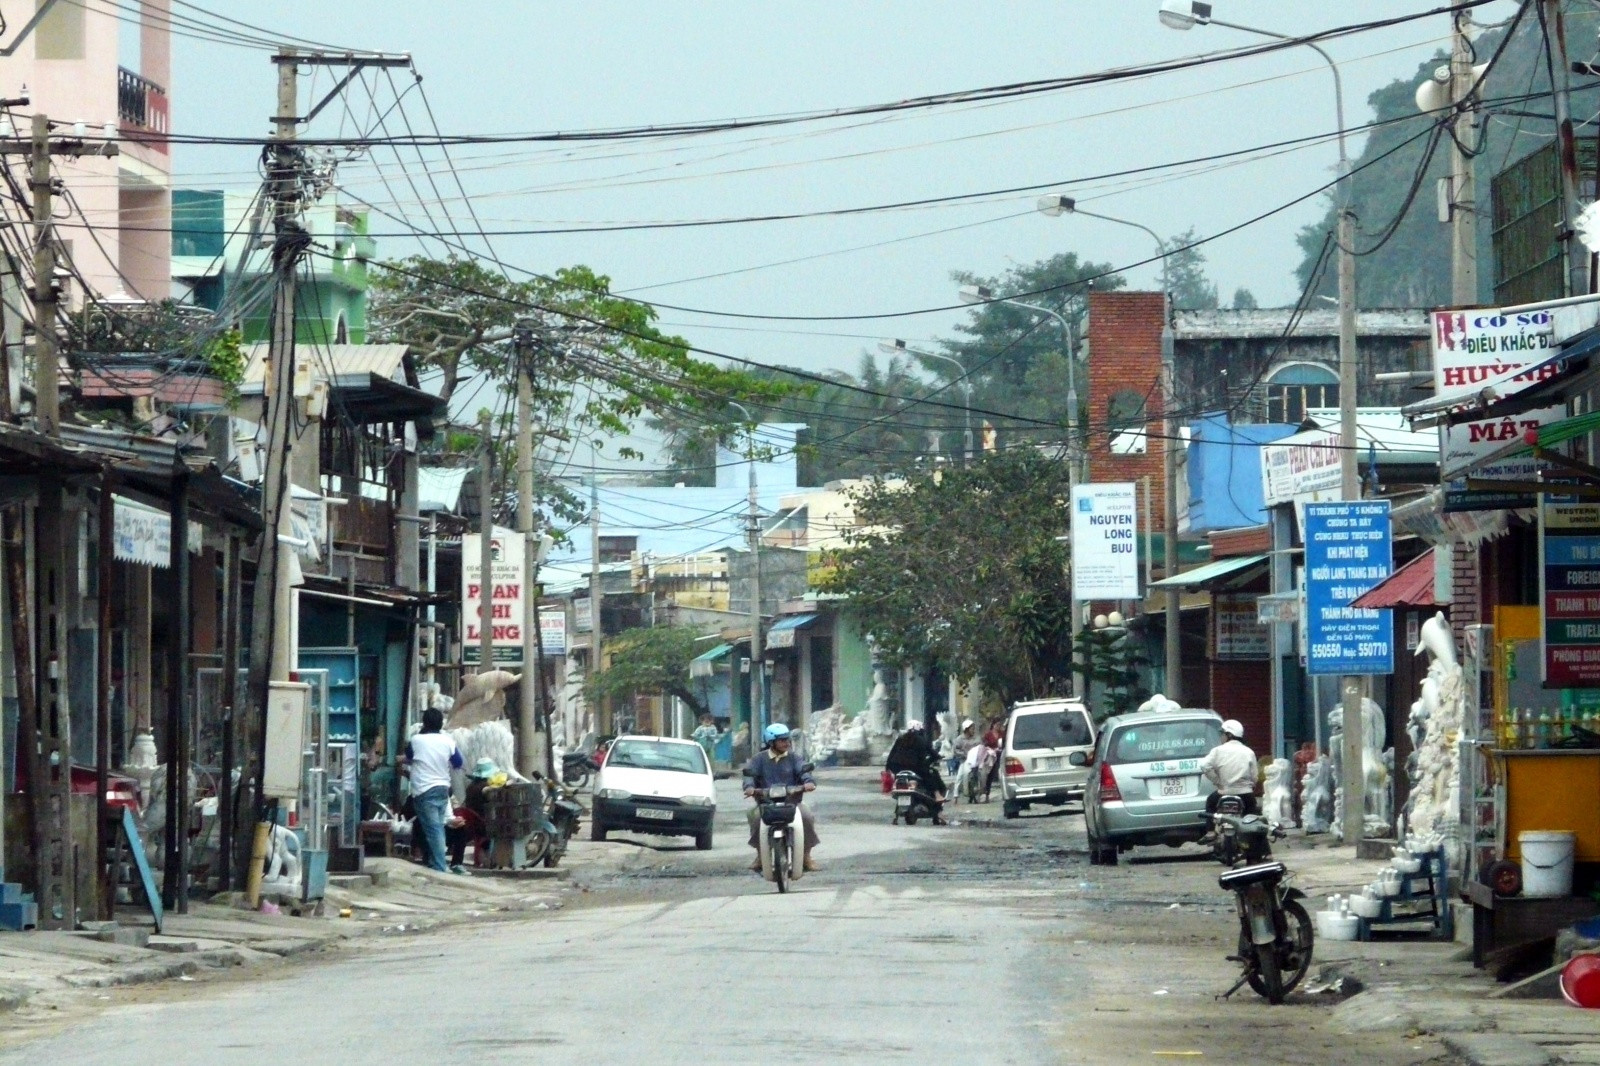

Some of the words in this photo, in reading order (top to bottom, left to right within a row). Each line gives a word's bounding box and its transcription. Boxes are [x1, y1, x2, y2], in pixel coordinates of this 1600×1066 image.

[1090, 514, 1132, 525] NGUYEN
[1105, 529, 1132, 539] LONG
[1112, 543, 1132, 553] BUU
[467, 584, 520, 598] PAN
[1556, 598, 1584, 612] THANH
[467, 625, 520, 639] LNG
[1312, 643, 1341, 658] 550550
[1358, 642, 1387, 656] 550770
[1149, 762, 1165, 772] 43S
[1179, 760, 1198, 770] 0637
[1163, 785, 1183, 795] 0637
